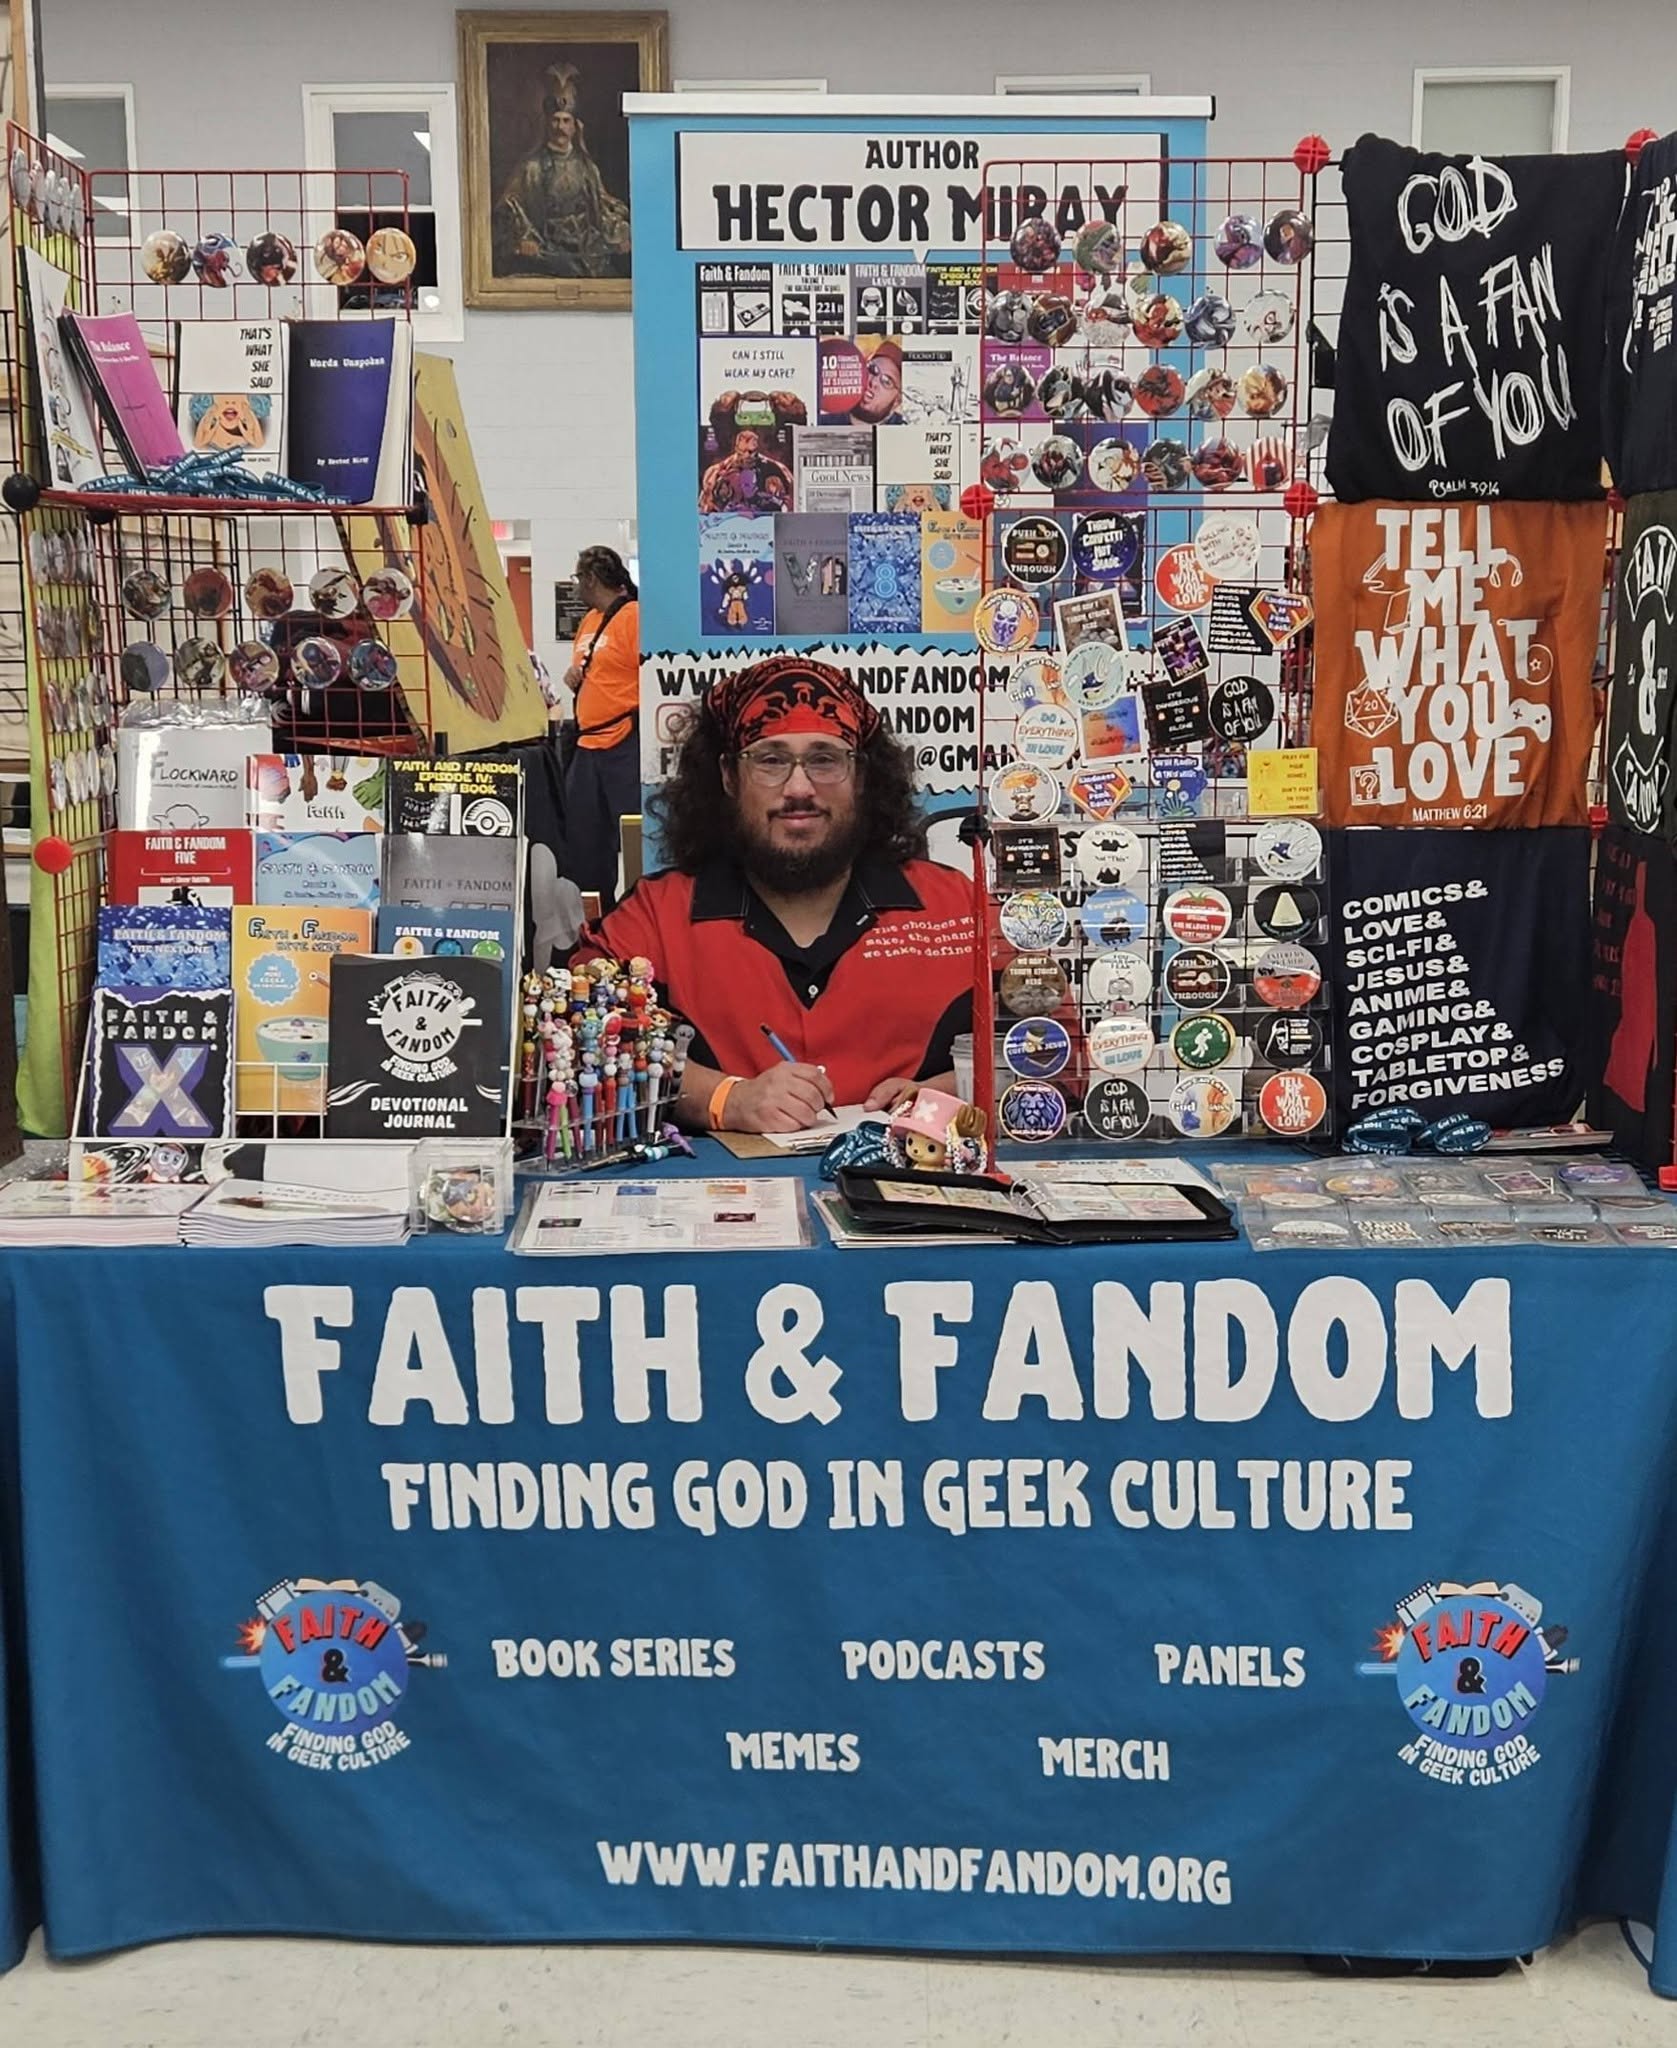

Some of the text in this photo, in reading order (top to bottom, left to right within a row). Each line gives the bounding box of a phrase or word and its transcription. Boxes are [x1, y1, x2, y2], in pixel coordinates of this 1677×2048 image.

[866, 140, 979, 169] AUTHOR
[1397, 154, 1518, 254] GOD
[713, 184, 930, 243] HECTOR
[701, 265, 723, 281] Faith
[734, 265, 770, 281] Fandom
[1377, 282, 1418, 373] IS
[1440, 275, 1478, 374] A
[1478, 242, 1563, 354] FAN
[240, 328, 273, 340] THAT'S
[245, 344, 273, 356] WHAT
[732, 350, 750, 360] CAN
[990, 353, 1007, 362] The
[252, 361, 269, 373] SHE
[310, 356, 385, 370] Words Unspoken
[822, 356, 837, 369] 10
[724, 368, 795, 378] WEAR MY CAPE?
[250, 376, 273, 389] SAID
[1387, 344, 1578, 472] OF YOU
[925, 432, 952, 442] THAT'S
[929, 445, 952, 455] WHAT
[934, 458, 949, 468] SHE
[811, 470, 870, 482] Good News
[933, 471, 951, 480] SAID
[1429, 479, 1466, 497] PSALM
[1376, 505, 1508, 571] TELL
[1011, 564, 1056, 574] THROUGH
[875, 563, 897, 599] 8
[1174, 592, 1205, 605] LOVE
[1404, 552, 1490, 630] ME
[1355, 619, 1537, 690] WHAT
[1010, 687, 1035, 702] God
[1223, 679, 1249, 698] GOD
[1222, 701, 1232, 718] IS
[1364, 699, 1379, 711] 20
[1388, 680, 1510, 744] YOU
[1040, 713, 1057, 723] DO
[1224, 713, 1263, 736] OF YOU
[1018, 725, 1076, 739] EVERYTHING
[393, 761, 519, 774] FAITH AND FANDOM
[1372, 736, 1526, 805] LOVE
[419, 772, 470, 783] EPISODE
[415, 783, 496, 795] A NEW BOOK
[307, 805, 345, 820] Faith
[1412, 804, 1488, 821] MATTHEW 6:21
[145, 837, 174, 850] FAITH
[184, 836, 226, 850] FANDOM
[175, 851, 197, 865] FIVE
[403, 878, 513, 891] FAITH FANDOM
[902, 919, 956, 931] choices
[395, 927, 500, 940] FAITH & FANDOM
[908, 933, 931, 943] the
[934, 930, 975, 943] chanc
[863, 951, 881, 959] we
[924, 945, 972, 956] define
[1172, 959, 1196, 967] PUSH
[393, 989, 451, 1013] FAITH
[107, 1009, 218, 1024] FAITH &
[415, 1016, 427, 1031] &
[107, 1026, 217, 1040] FANDOM
[386, 1028, 455, 1053] FANDOM
[1092, 1034, 1148, 1048] EVERYTHING
[389, 1055, 451, 1073] FINDING GOD
[416, 1061, 458, 1083] CULTURE
[108, 1043, 214, 1137] X
[1104, 1082, 1128, 1096] GOD
[1279, 1076, 1304, 1089] TELL
[1351, 1057, 1565, 1109] FORGIVENESS
[370, 1097, 468, 1112] DEVOTIONAL
[1171, 1101, 1196, 1112] God
[1275, 1095, 1311, 1109] WHAT
[383, 1114, 456, 1129] JOURNAL
[1103, 1114, 1140, 1130] OF YOU
[1277, 1115, 1307, 1127] LOVE
[264, 1276, 1512, 1425] FAITH & FANDOM
[381, 1459, 1413, 1536] FINDING GOD IN GEEK CULTURE
[271, 1604, 391, 1654] FAITH
[1410, 1609, 1531, 1663] FAITH
[491, 1638, 736, 1677] BOOK SERIES
[841, 1639, 1046, 1682] PODCASTS
[321, 1648, 351, 1684] &
[1154, 1643, 1306, 1688] PANELS
[1457, 1655, 1488, 1694] &
[269, 1671, 402, 1722] FANDOM
[1403, 1681, 1537, 1736] FANDOM
[282, 1720, 397, 1754] FINDING GOD
[266, 1730, 412, 1772] IN GEEK CULTURE
[726, 1731, 861, 1772] MEMES
[1038, 1736, 1170, 1781] MERCH
[1414, 1733, 1529, 1769] FINDING GOD
[1397, 1743, 1541, 1786] IN GEEK CULTURE
[596, 1841, 1232, 1905] WWW.FAITHANDFANDOM.ORG
